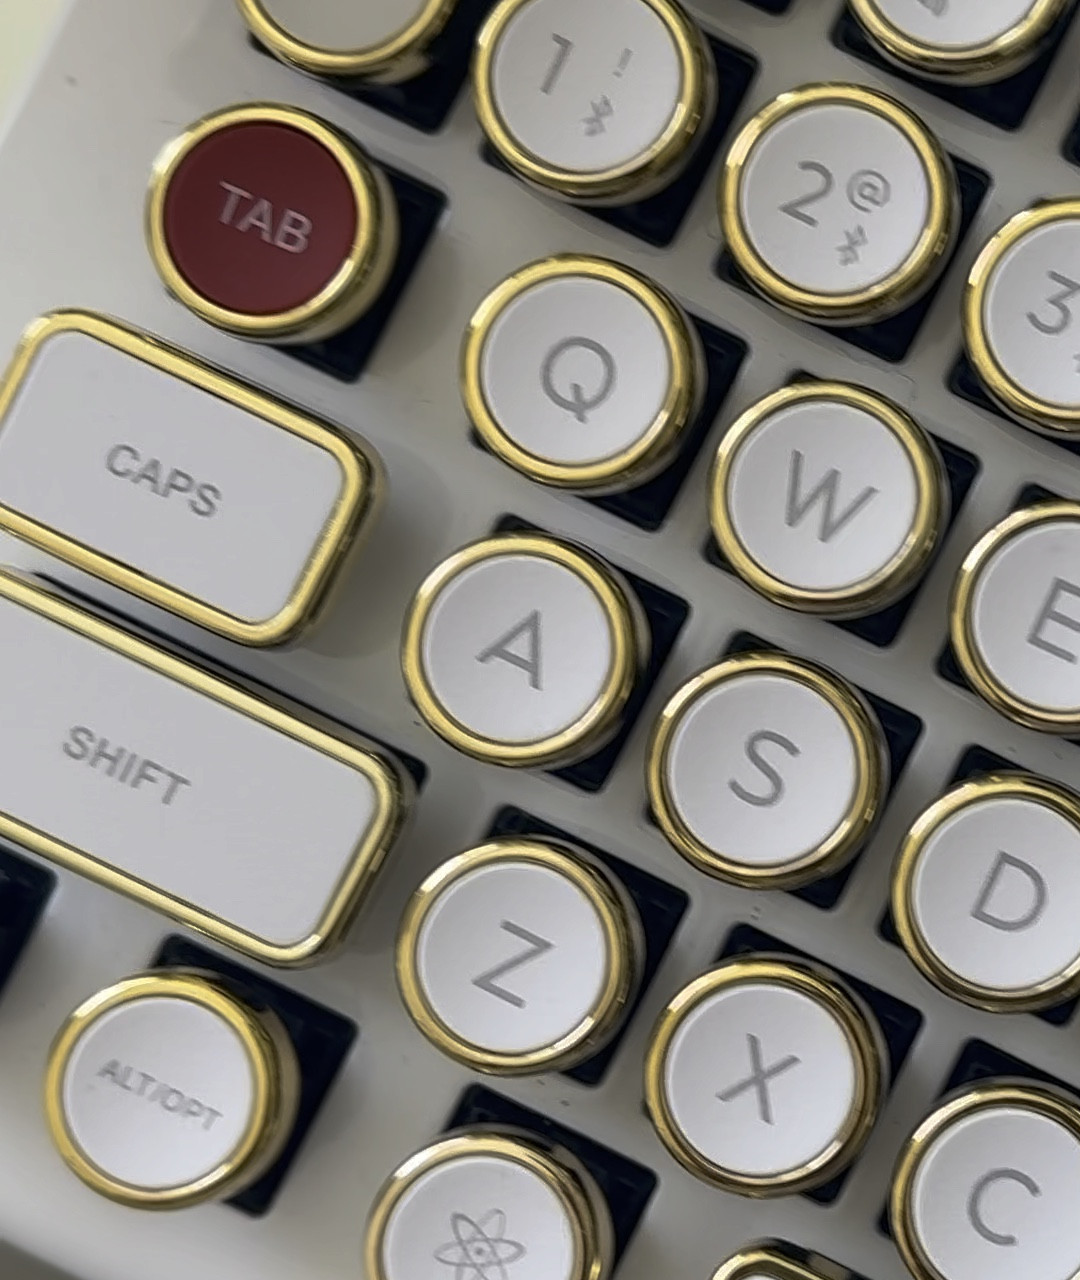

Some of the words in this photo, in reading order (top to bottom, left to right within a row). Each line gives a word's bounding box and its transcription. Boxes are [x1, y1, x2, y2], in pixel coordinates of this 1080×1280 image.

[540, 32, 574, 95] 1
[217, 180, 313, 255] TAB
[778, 160, 835, 228] 2
[845, 168, 891, 213] @
[540, 335, 618, 425] Q
[104, 443, 223, 520] CAPS
[784, 449, 883, 544] W
[475, 609, 544, 692] A
[61, 724, 192, 807] SHIFT
[727, 730, 802, 808] S
[970, 850, 1049, 932] D
[471, 918, 557, 1009] Z
[96, 1059, 224, 1131] ALT/OPT
[715, 1032, 802, 1125] X
[966, 1166, 1042, 1248] C
